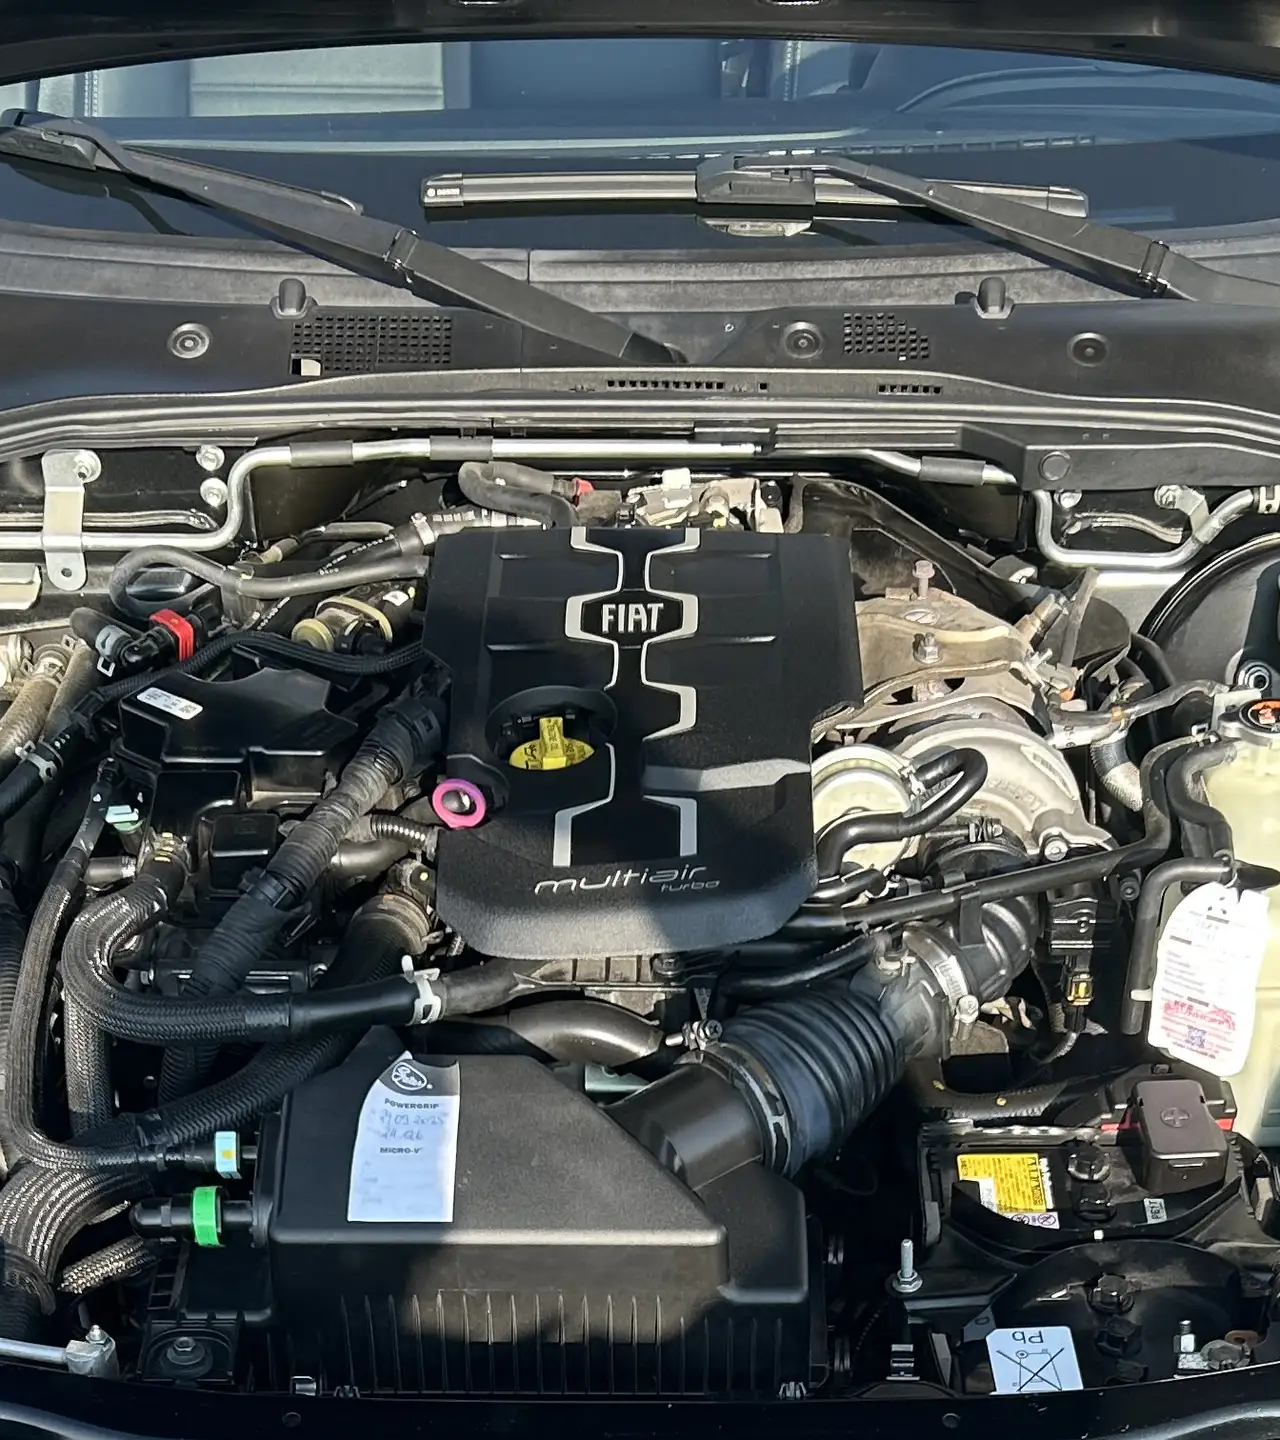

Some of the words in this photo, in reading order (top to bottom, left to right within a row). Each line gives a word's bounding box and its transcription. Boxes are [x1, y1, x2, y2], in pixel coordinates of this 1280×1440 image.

[601, 602, 665, 634] FIAT
[534, 864, 707, 896] multiair
[661, 878, 720, 893] turbo
[384, 1097, 440, 1109] POWERGRIP
[1012, 1330, 1044, 1345] Pb
